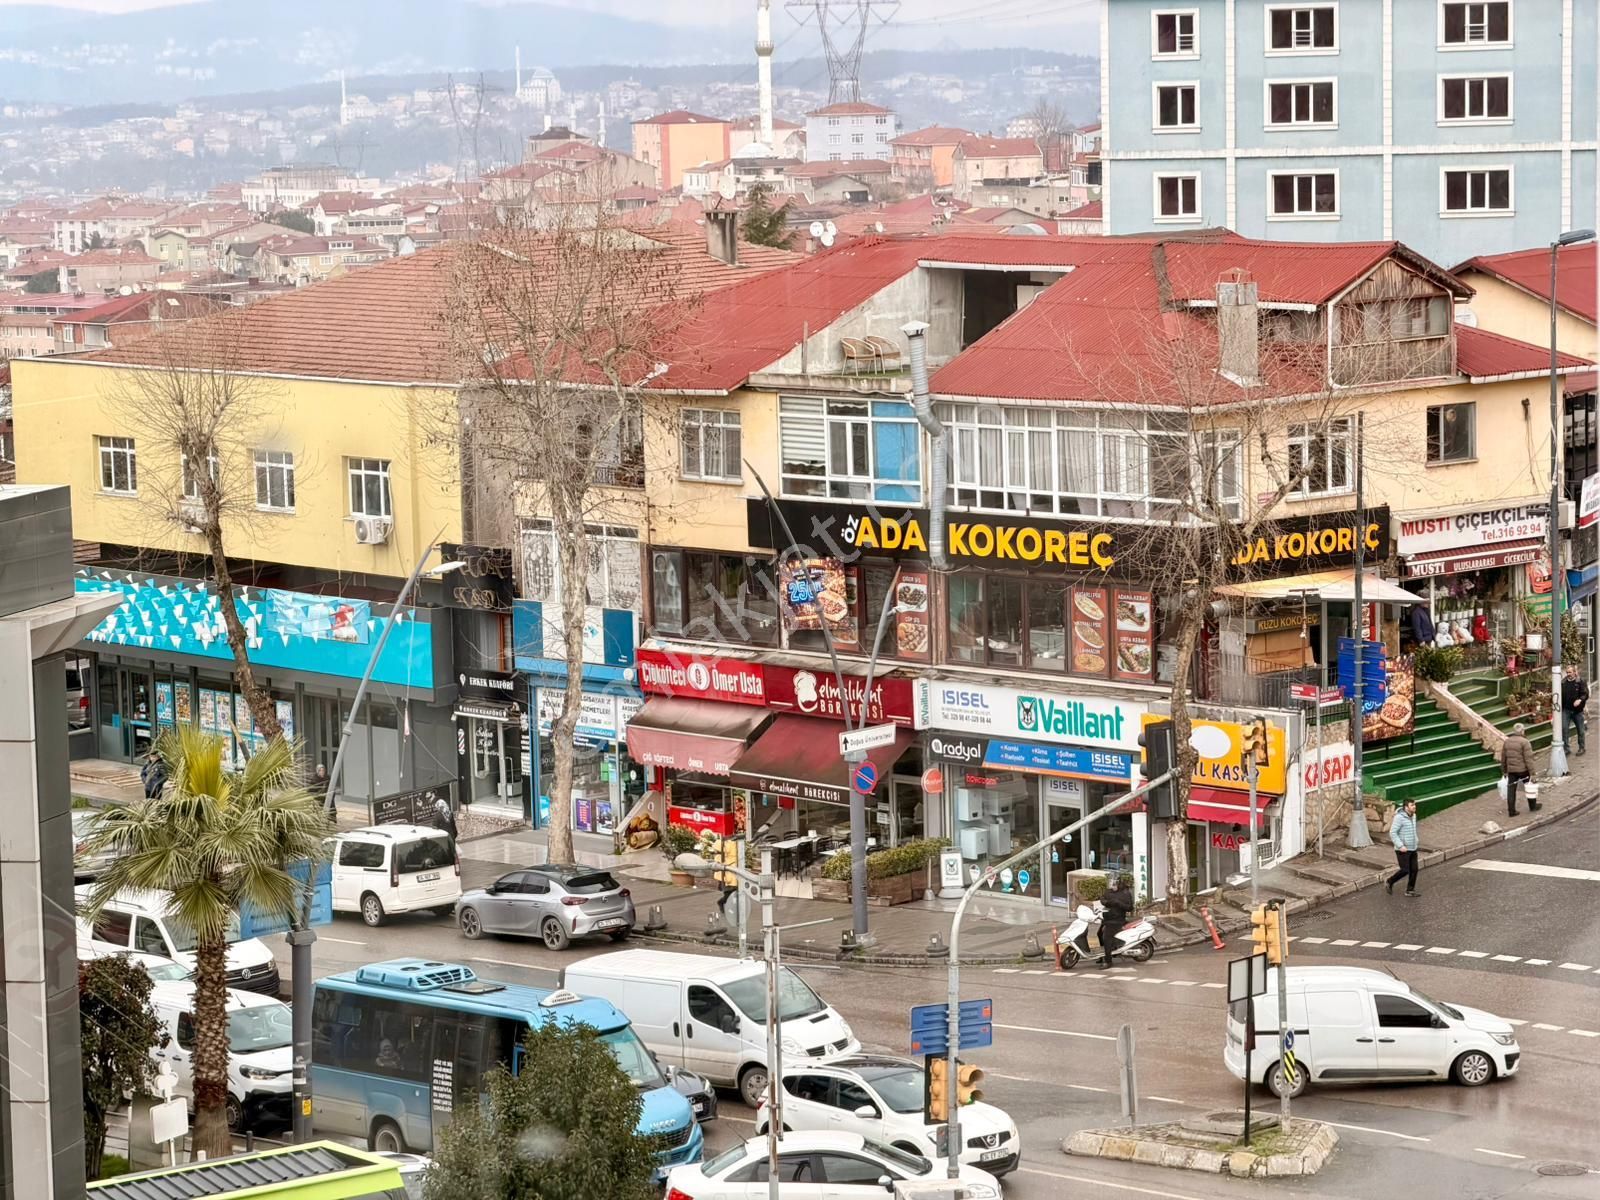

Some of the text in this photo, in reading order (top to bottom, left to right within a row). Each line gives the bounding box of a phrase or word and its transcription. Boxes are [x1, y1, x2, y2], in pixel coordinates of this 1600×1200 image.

[1401, 504, 1546, 537] MUSTİ ÇİÇEKÇİL
[1517, 523, 1528, 536] 92
[1530, 522, 1541, 535] 94
[841, 514, 1114, 571] ÖZ ADA KOKOREÇ
[1231, 537, 1270, 565] DA
[1258, 613, 1318, 631] KUZU KOKOEÇ
[469, 676, 488, 688] ERKEK
[641, 662, 763, 695] Çiğköfteci Ömer Usta
[820, 699, 884, 719] BÖRKİSİ
[920, 682, 929, 719] Vaillant
[1039, 697, 1125, 741] Vaillant
[1091, 753, 1125, 766] ISISEL
[1212, 762, 1259, 782] KASA
[1050, 779, 1080, 792] ISISEL
